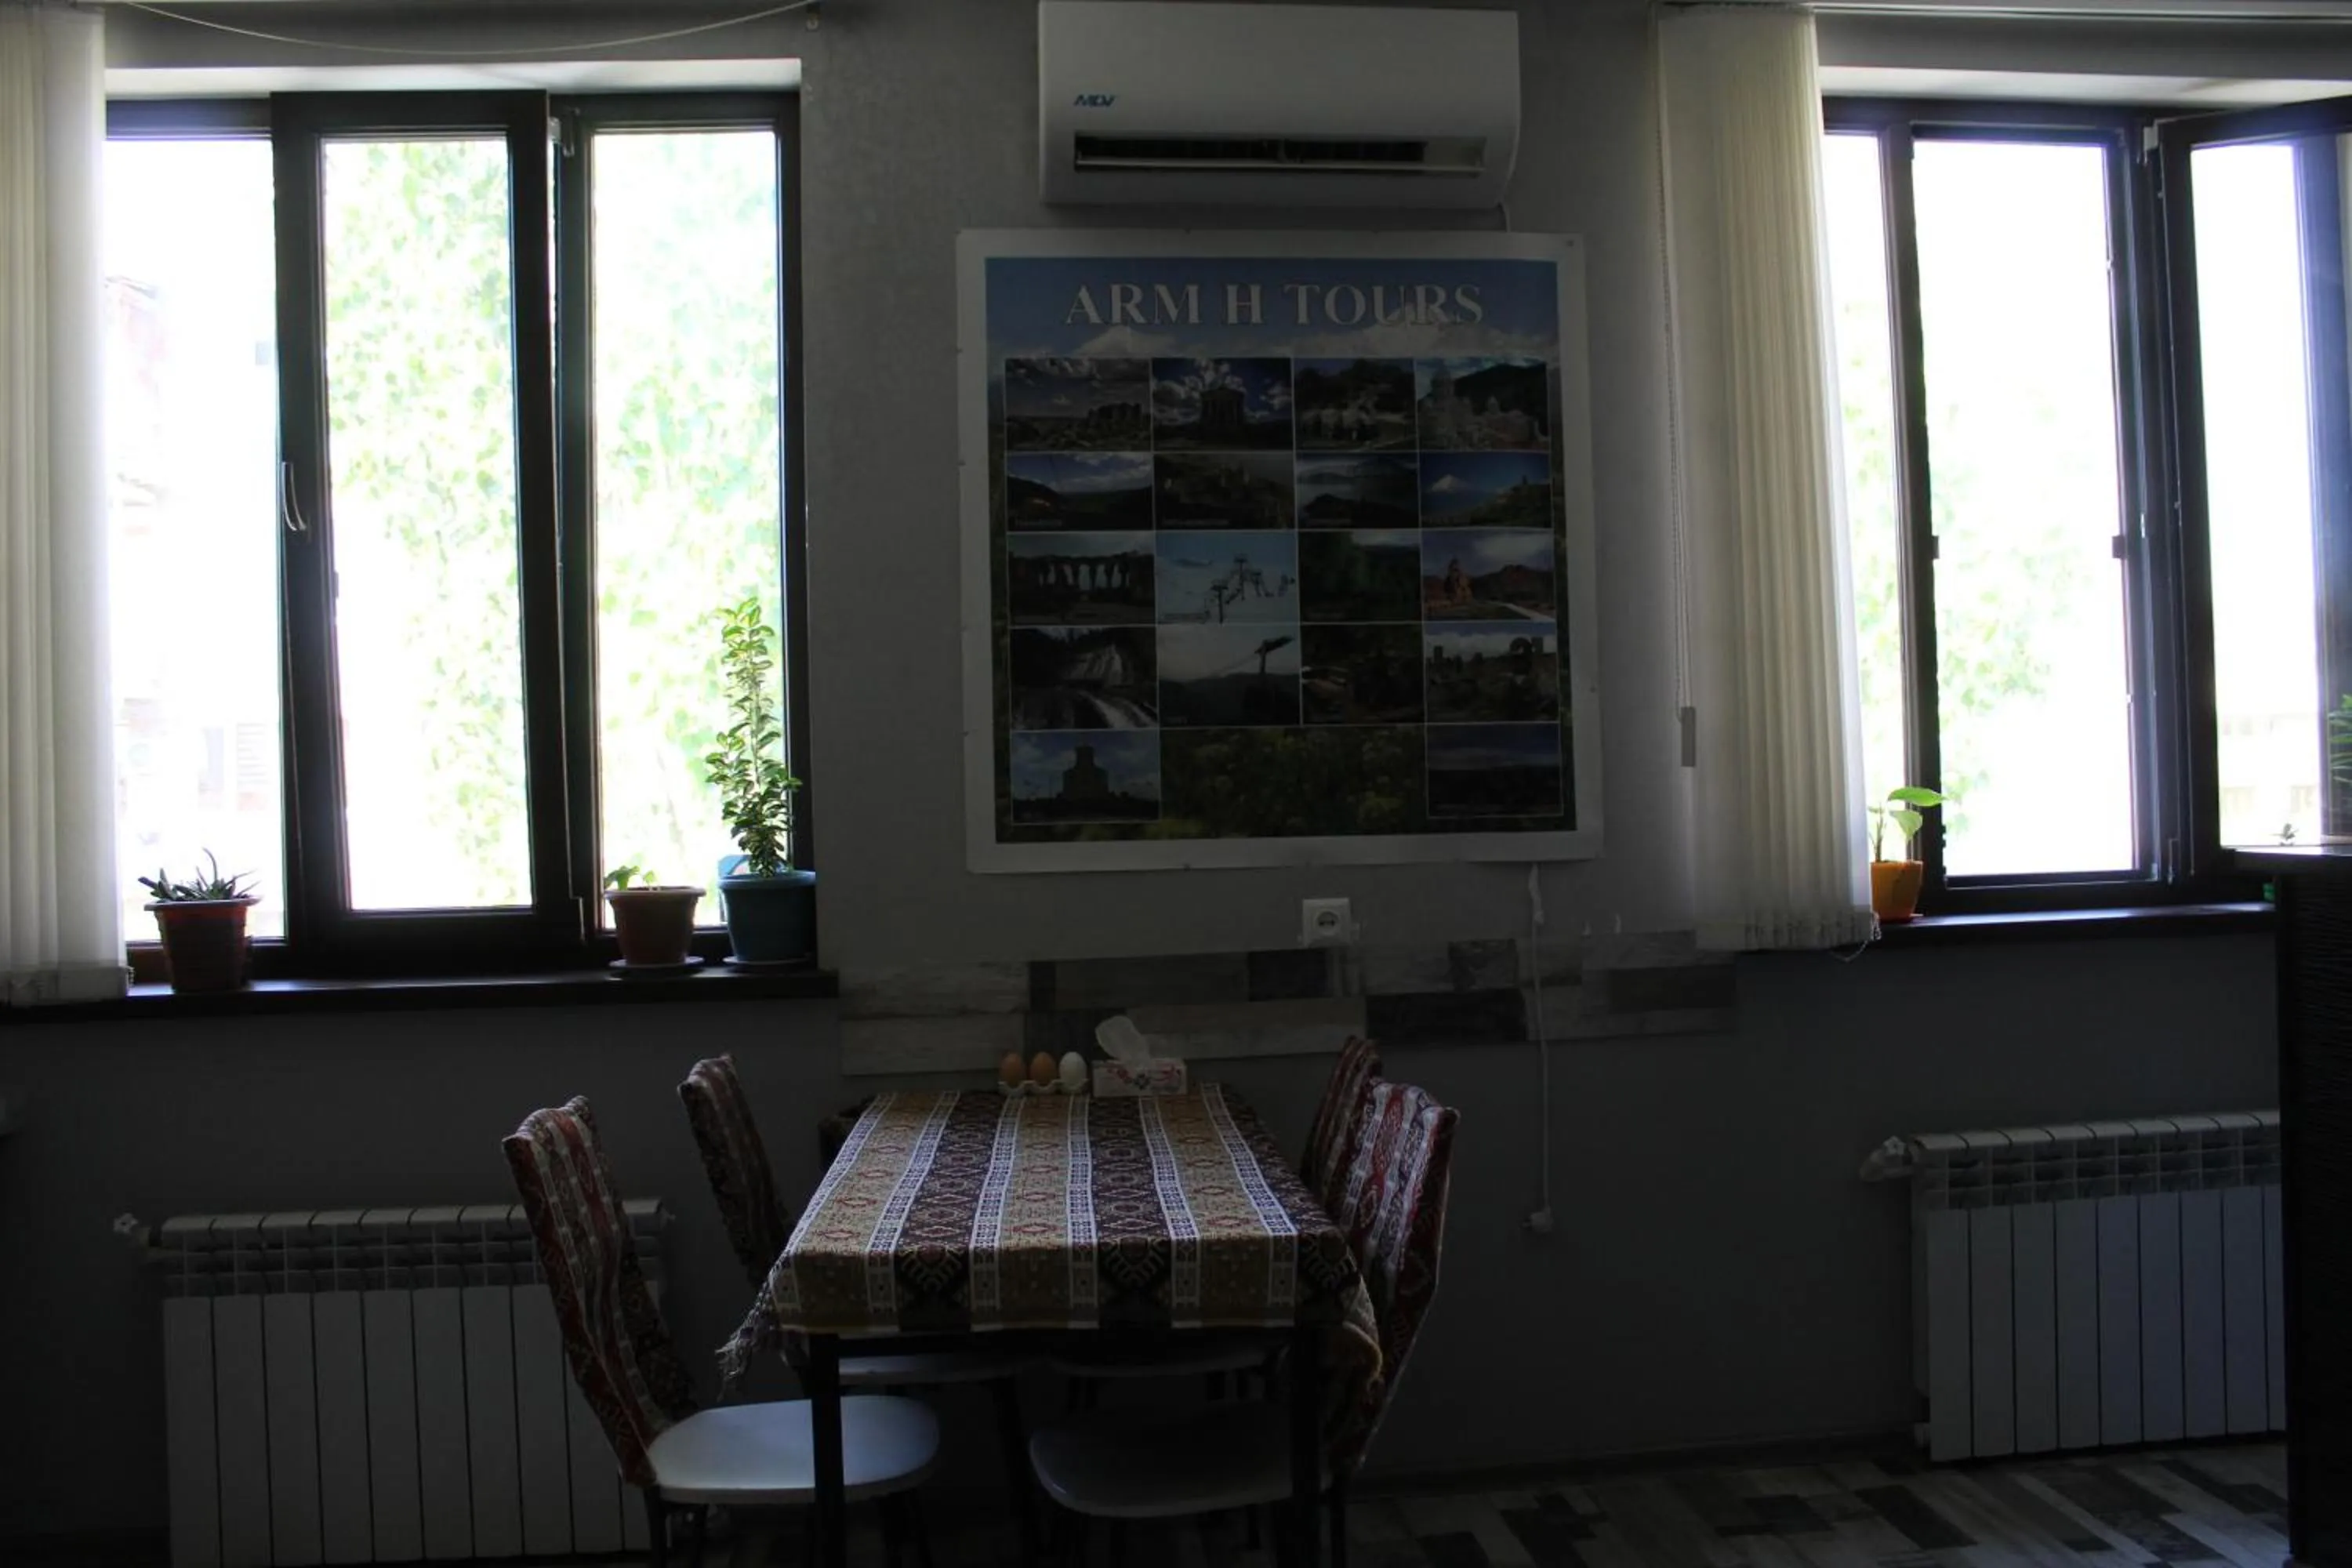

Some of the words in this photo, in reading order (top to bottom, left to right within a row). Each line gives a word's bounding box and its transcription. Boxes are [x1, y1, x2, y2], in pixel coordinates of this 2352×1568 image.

[1073, 94, 1115, 107] MDV
[1065, 283, 1202, 325] ARM
[1225, 283, 1265, 324] H
[1283, 283, 1484, 326] TOURS
